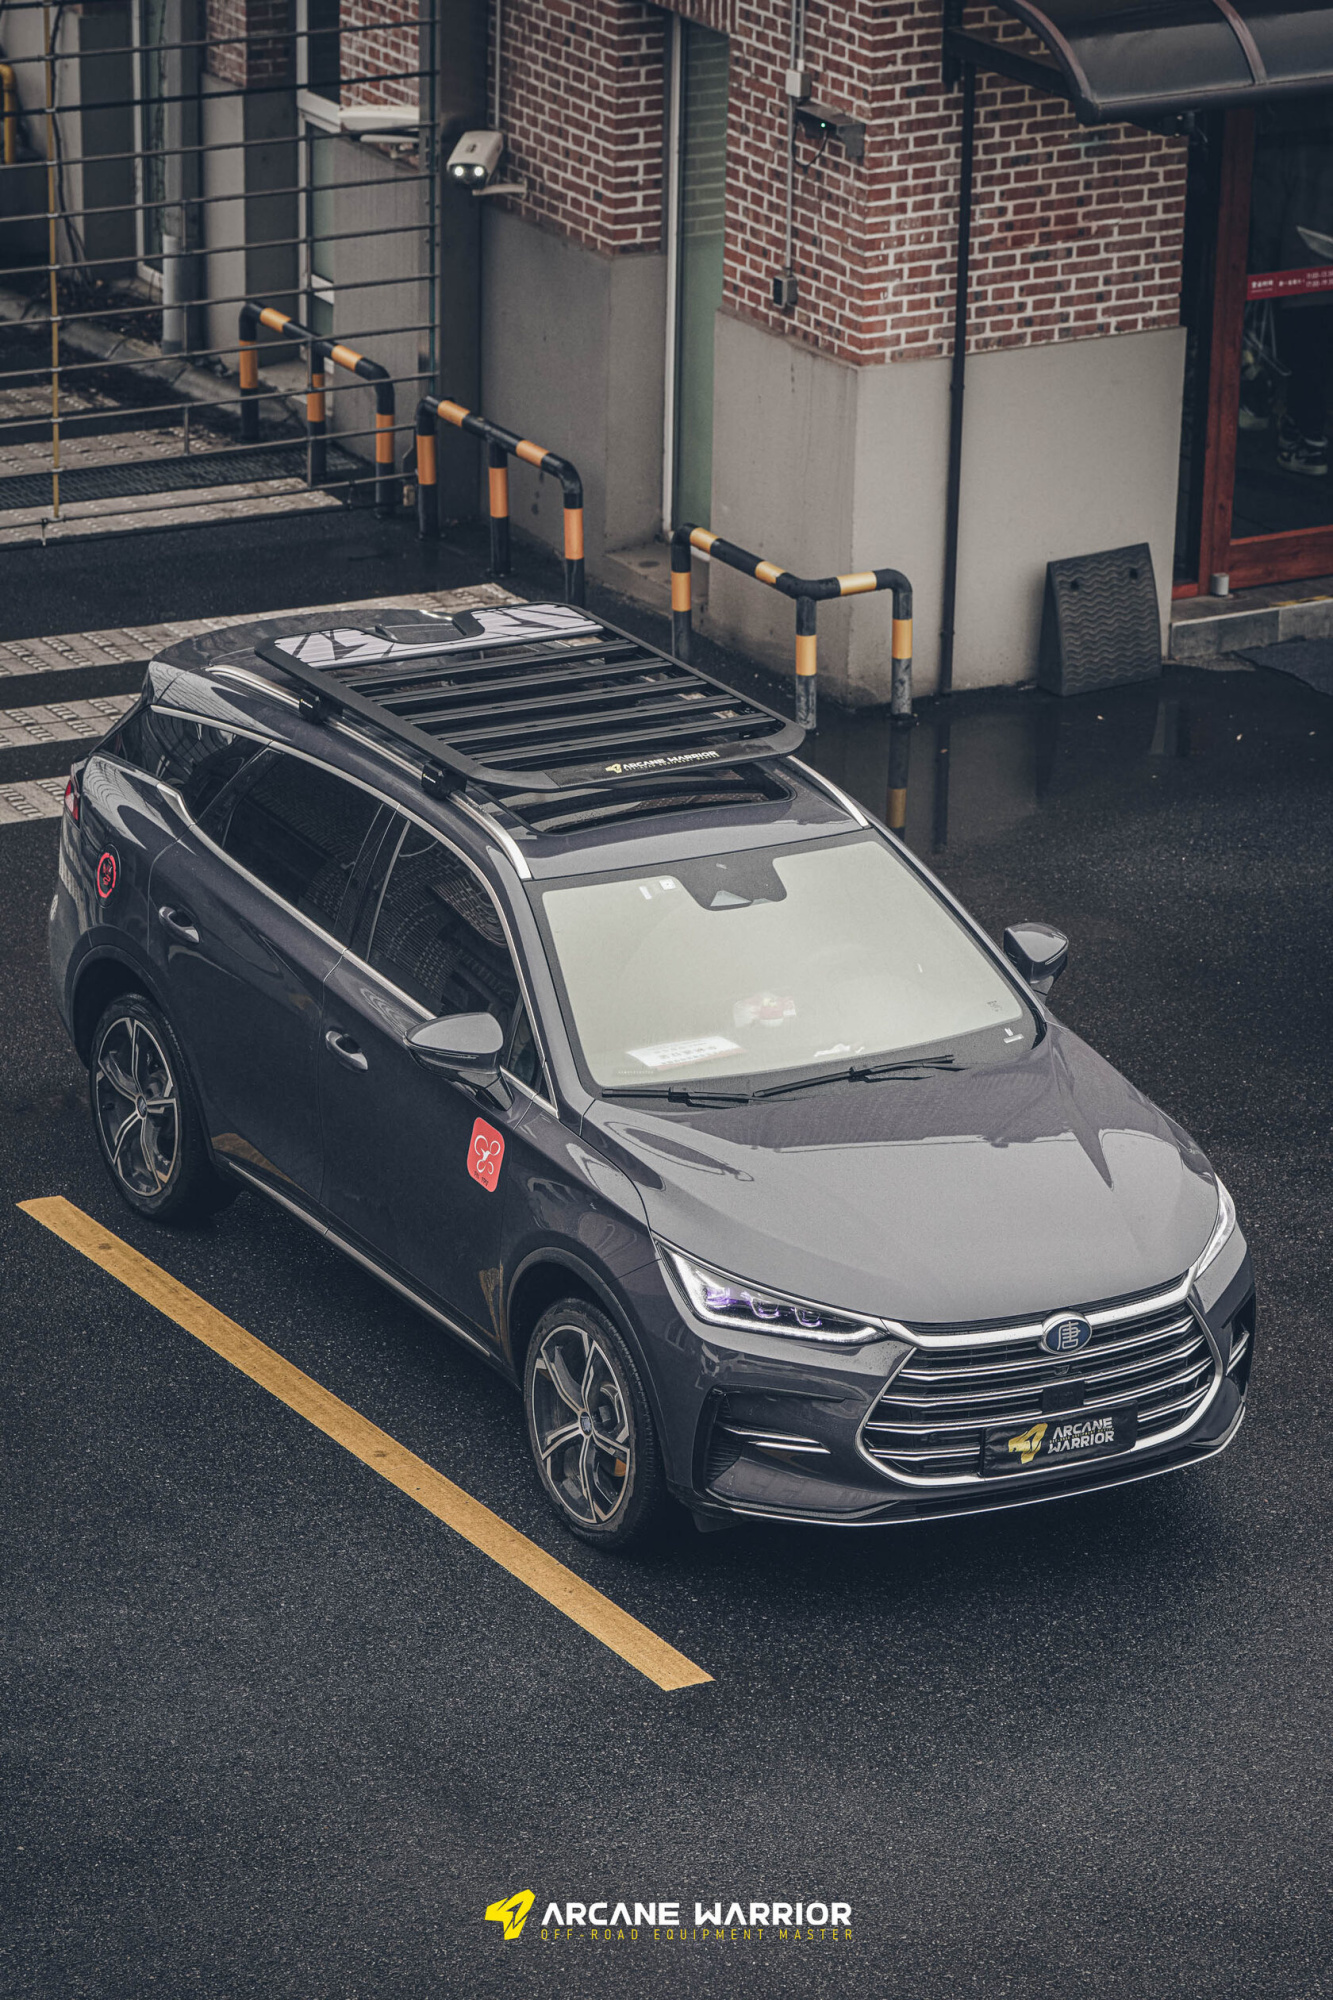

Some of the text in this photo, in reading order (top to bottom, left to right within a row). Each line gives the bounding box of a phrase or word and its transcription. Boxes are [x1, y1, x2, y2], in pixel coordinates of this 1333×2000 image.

[622, 758, 666, 770] ARCANE
[667, 750, 718, 763] WARRIOR
[1057, 1321, 1081, 1351] 唐
[1053, 1417, 1113, 1439] ARCANE
[1048, 1430, 1115, 1454] WARRIOR
